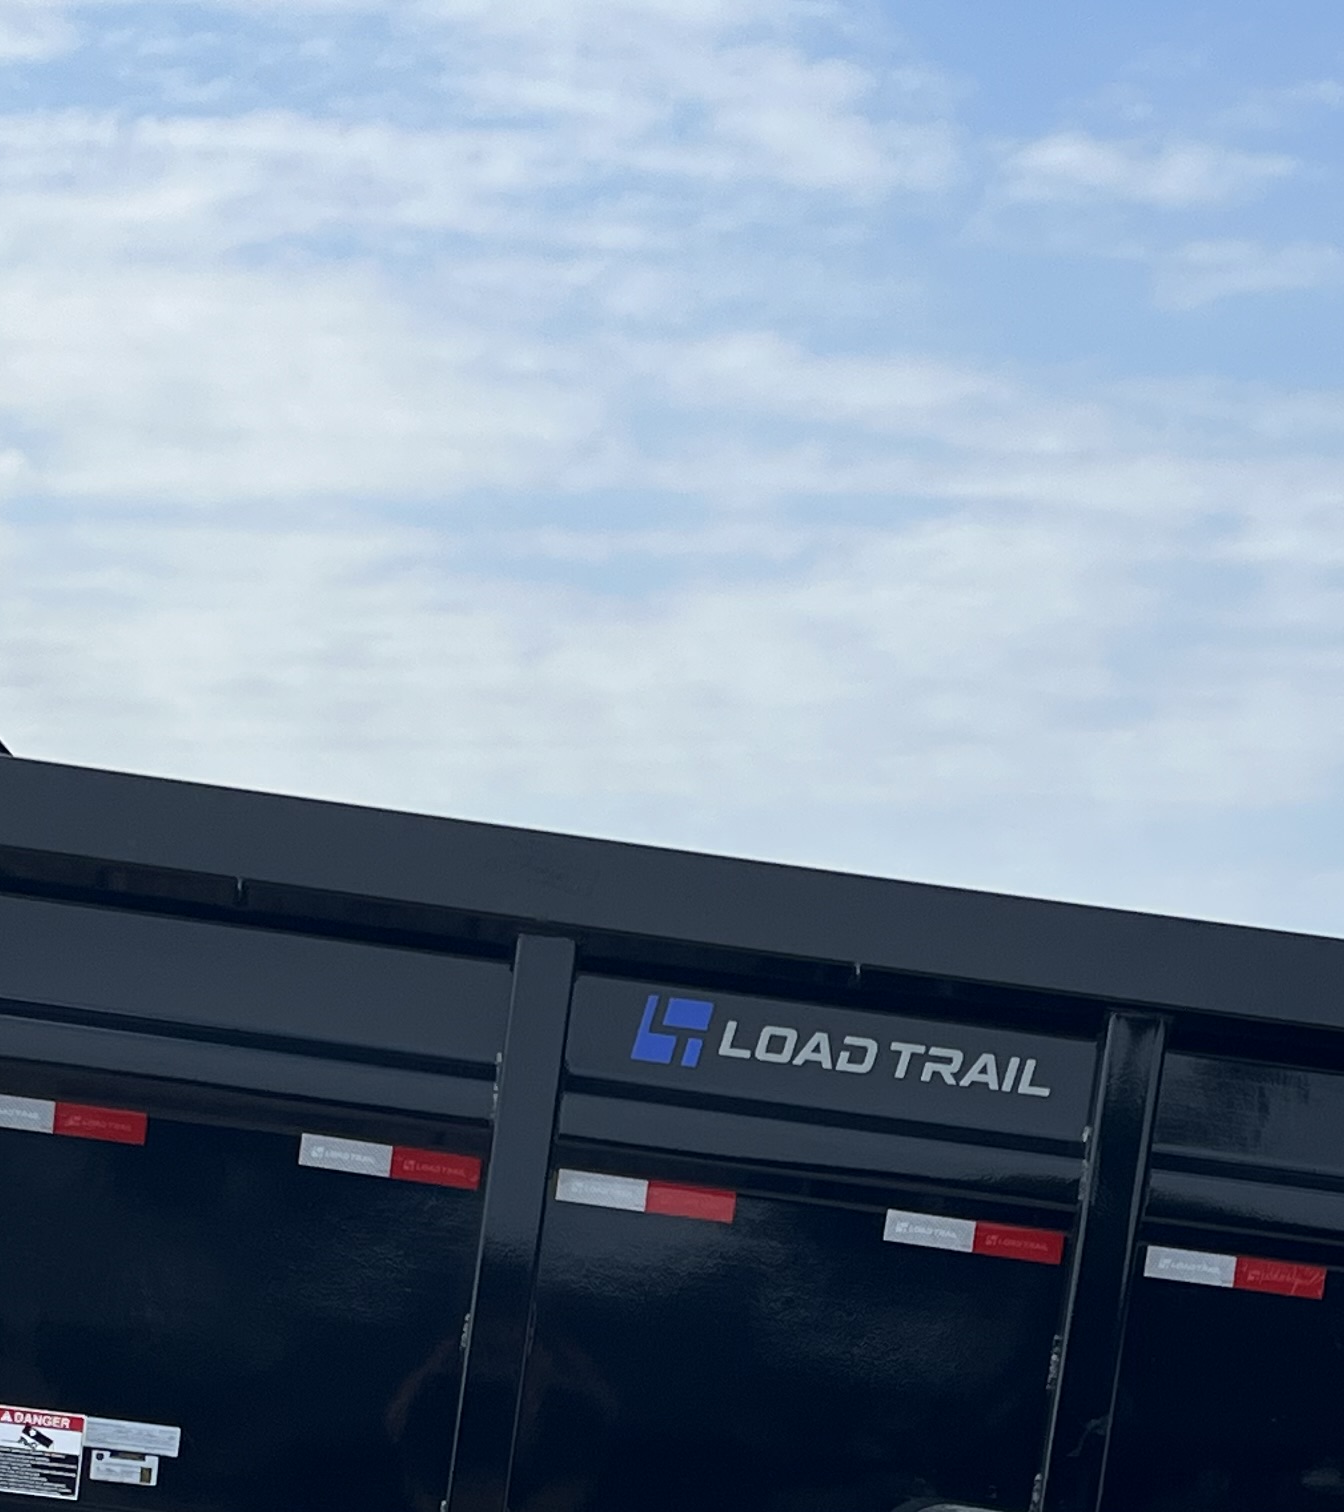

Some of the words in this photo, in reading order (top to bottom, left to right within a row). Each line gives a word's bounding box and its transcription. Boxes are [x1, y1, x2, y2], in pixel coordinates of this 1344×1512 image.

[718, 1020, 879, 1074] LOAD
[889, 1041, 1052, 1098] TRAIL
[13, 1412, 72, 1430] DANGER
